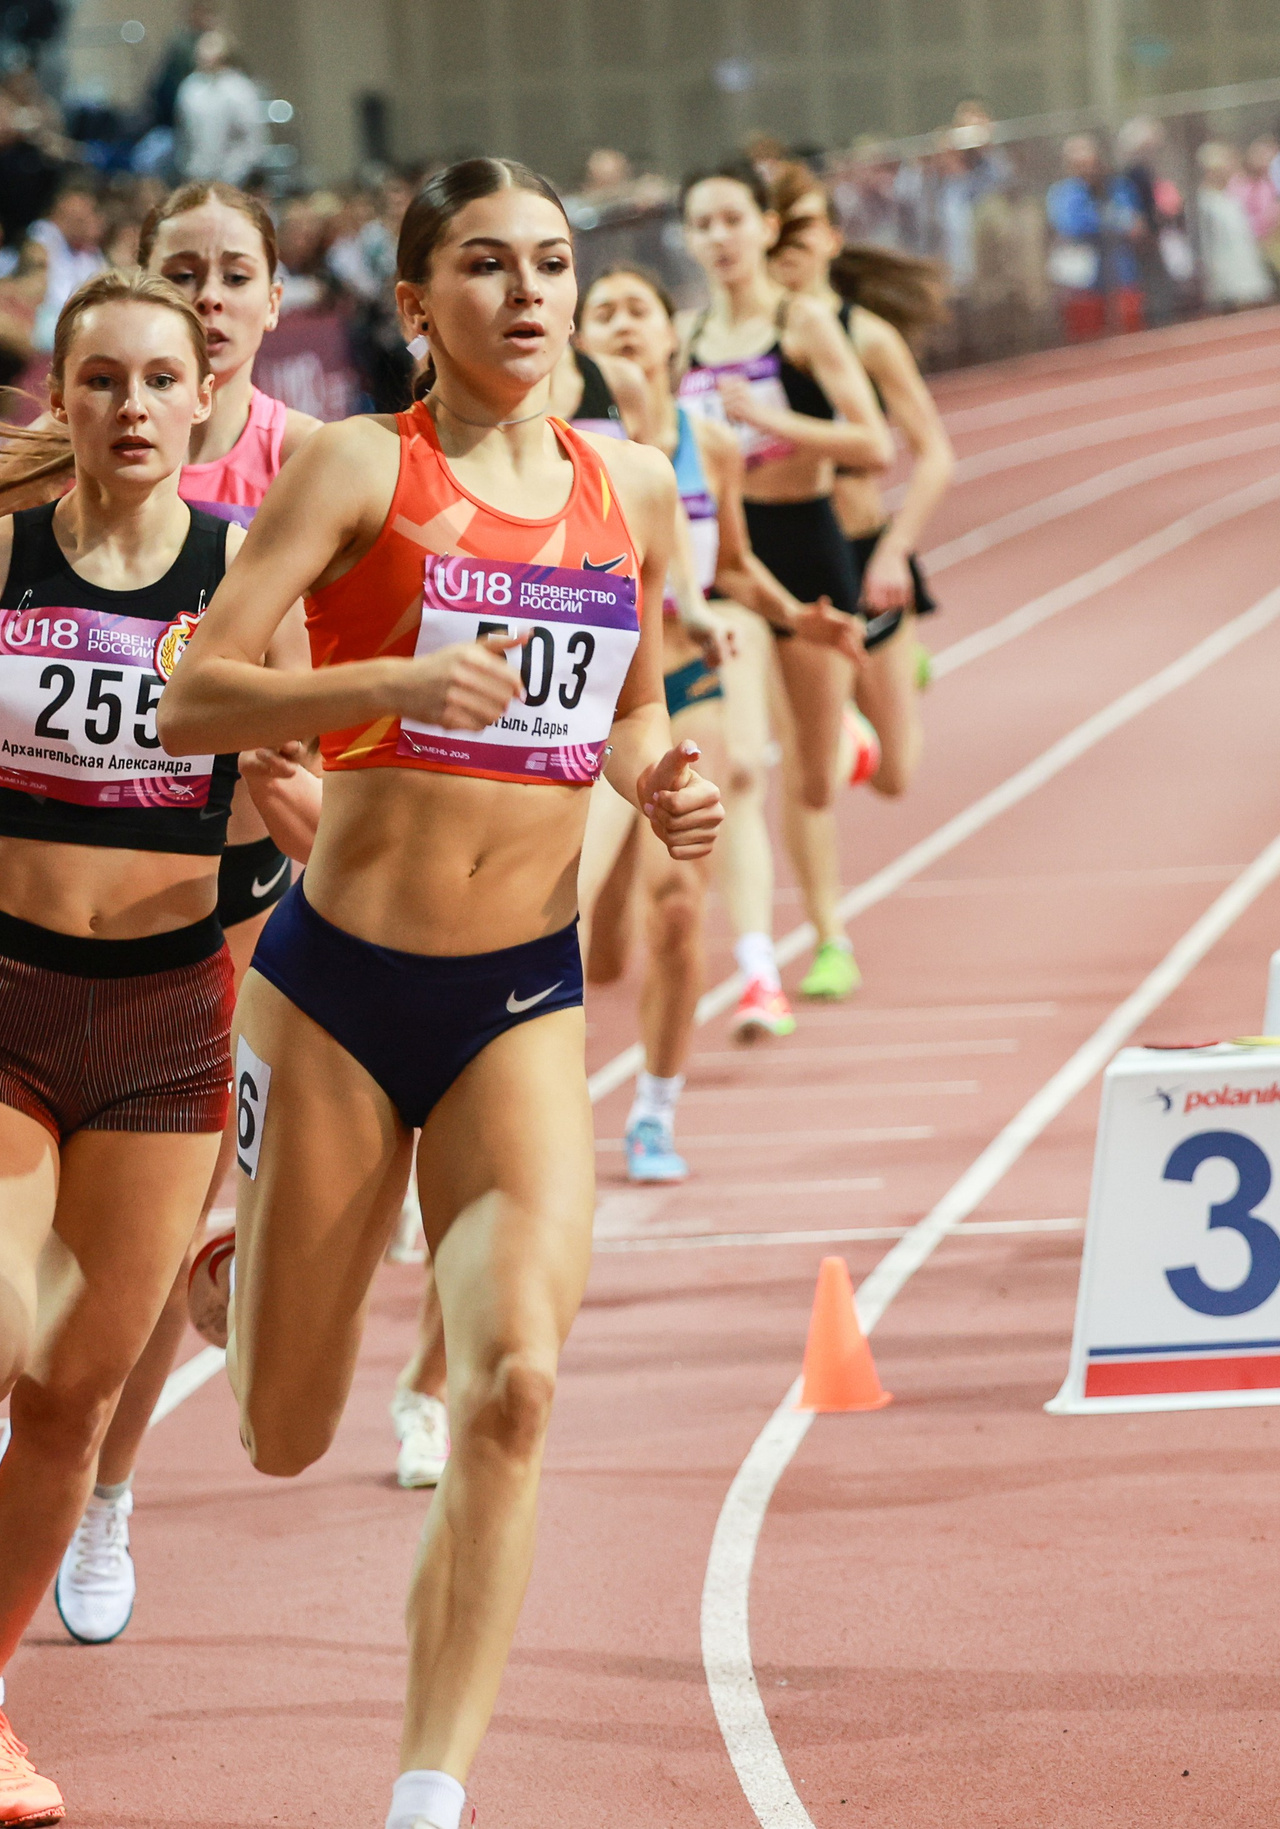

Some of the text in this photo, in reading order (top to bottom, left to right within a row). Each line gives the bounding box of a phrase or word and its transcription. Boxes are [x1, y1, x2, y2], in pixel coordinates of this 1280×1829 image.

[437, 567, 512, 605] U18
[520, 582, 617, 605] ПЕРВЕНСТВО
[520, 595, 583, 614] РОССИИ
[6, 618, 79, 649] U18
[87, 640, 154, 659] РОССИИ
[35, 664, 167, 749] 255
[531, 717, 569, 739] Дарья
[2, 739, 193, 774] Архангельская Александра
[238, 1070, 259, 1149] 6
[1162, 1129, 1280, 1317] 3
